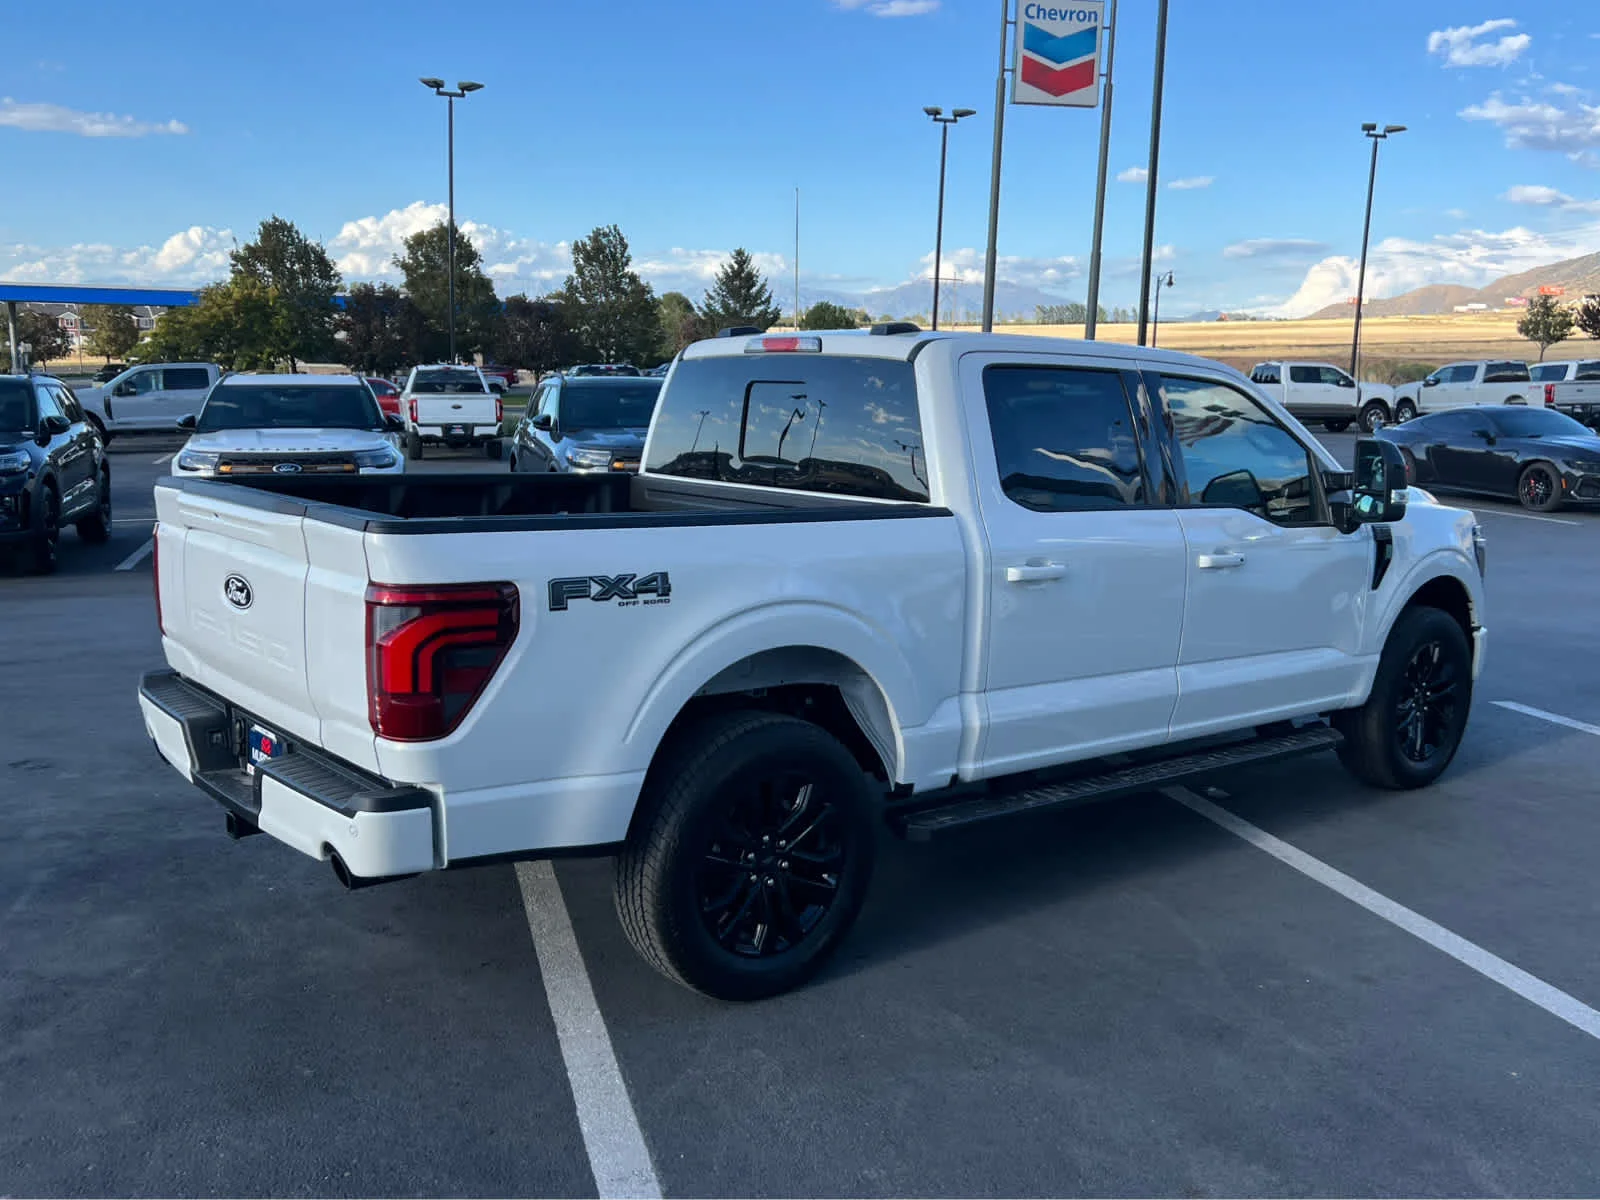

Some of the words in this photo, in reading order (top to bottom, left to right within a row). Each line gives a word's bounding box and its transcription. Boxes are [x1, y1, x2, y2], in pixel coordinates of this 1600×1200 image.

[1024, 3, 1098, 23] Chevron
[225, 577, 248, 605] Ford
[548, 571, 671, 611] FX4
